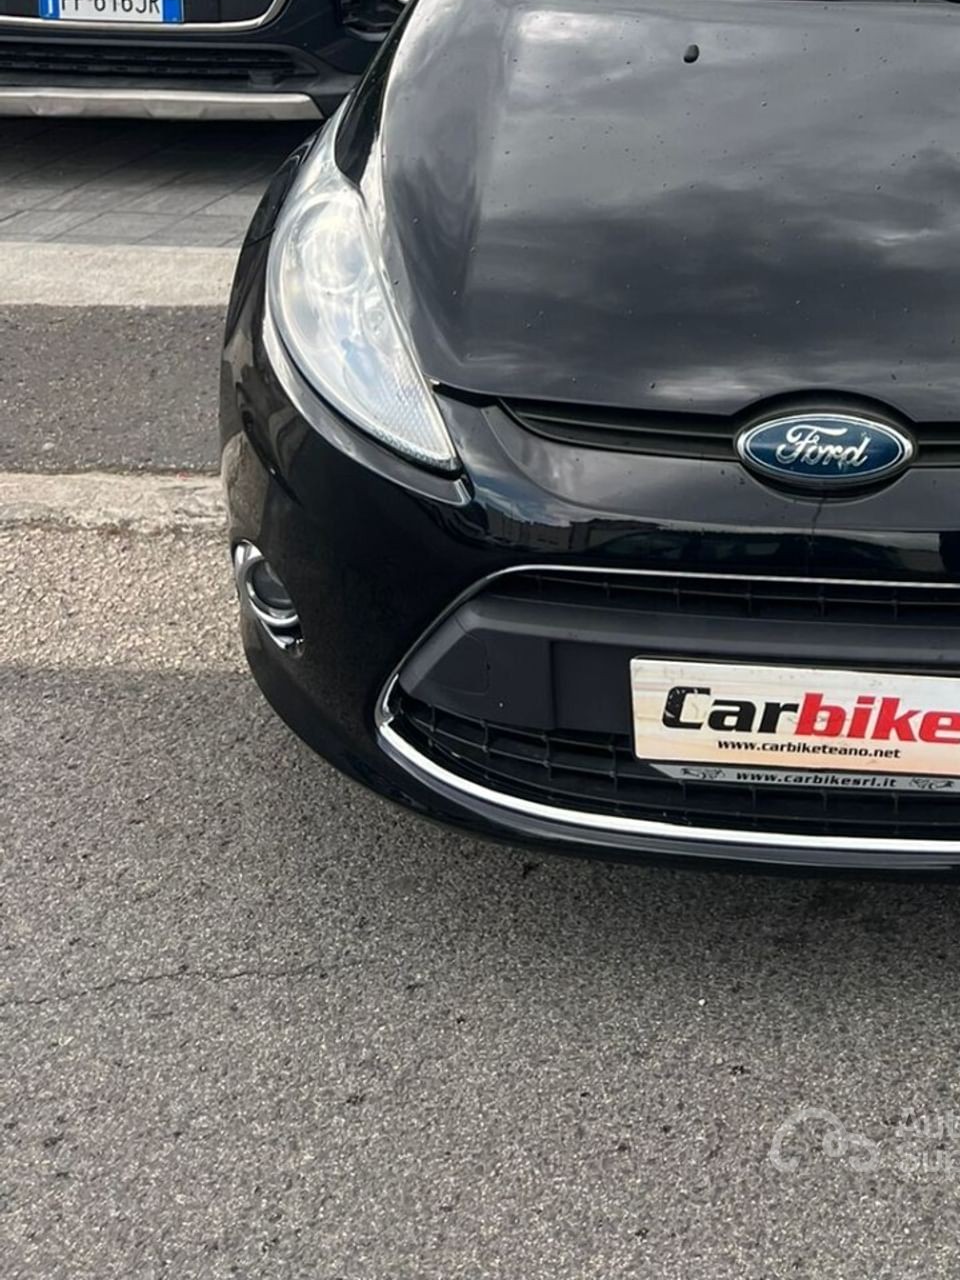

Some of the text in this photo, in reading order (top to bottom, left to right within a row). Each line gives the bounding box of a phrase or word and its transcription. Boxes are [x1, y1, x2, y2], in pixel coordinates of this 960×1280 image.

[776, 424, 872, 470] Ford
[717, 738, 902, 760] www.carbiketeano.net
[735, 770, 897, 789] www.carbikesrl.it
